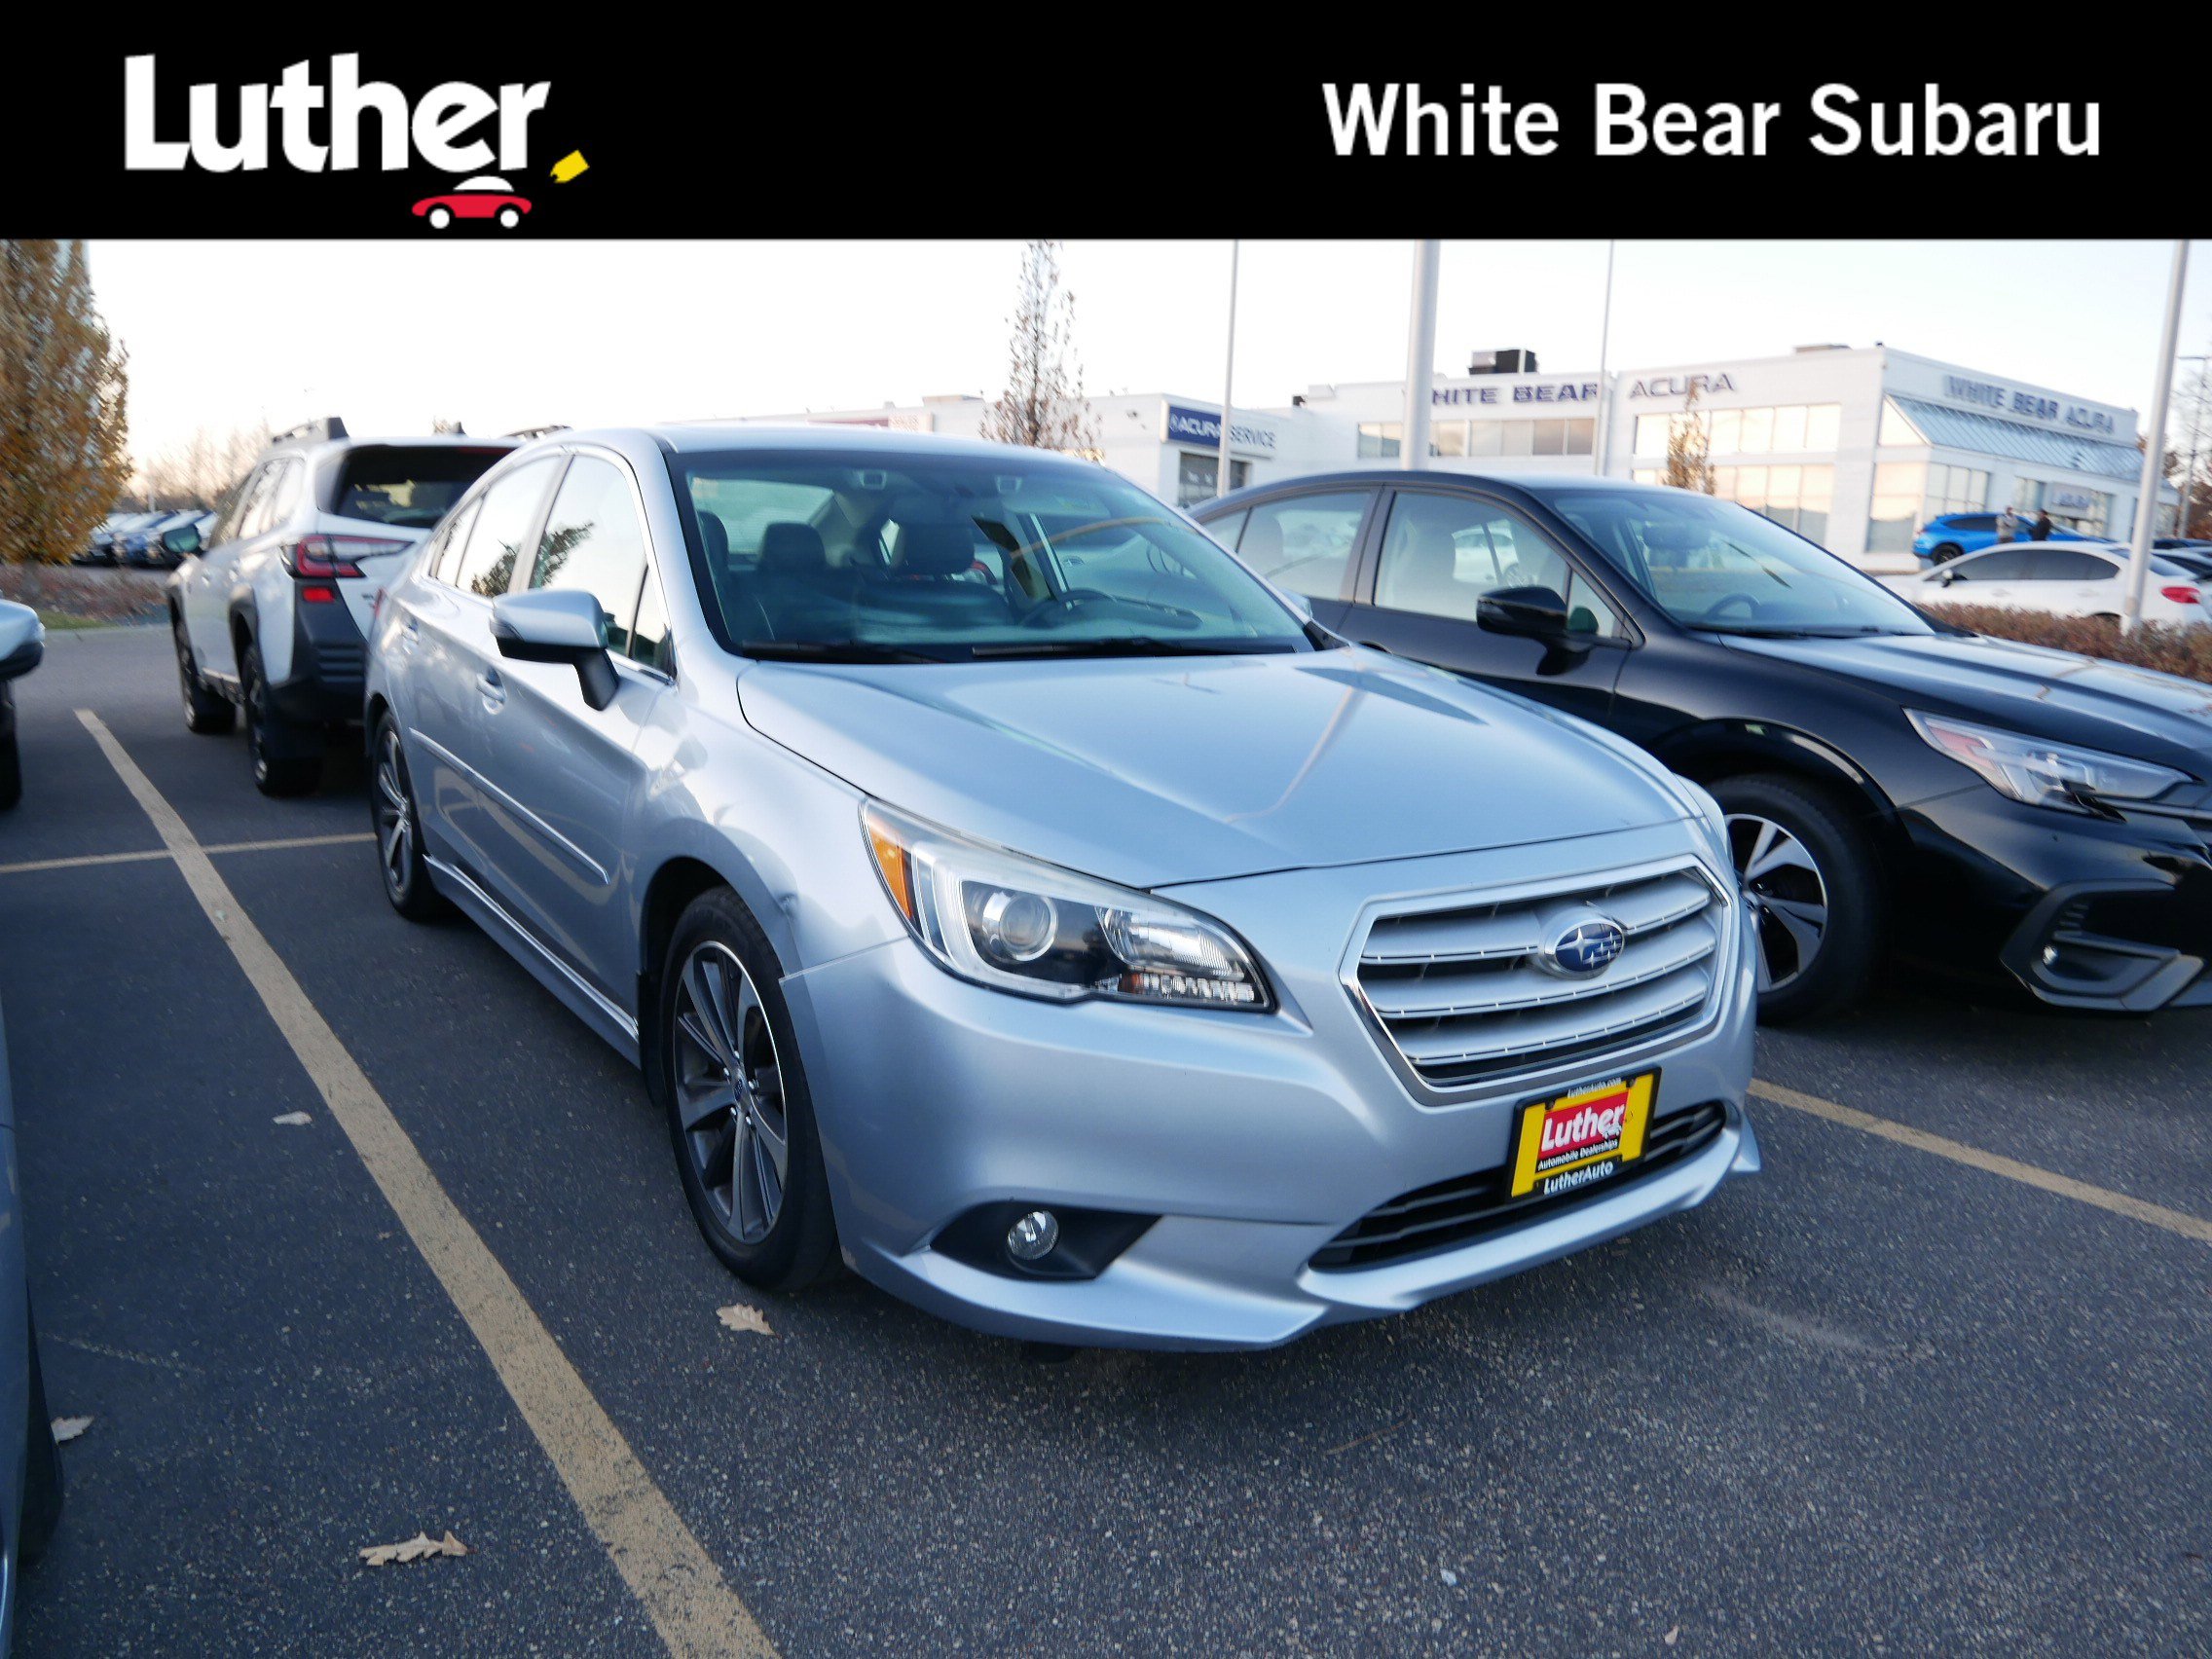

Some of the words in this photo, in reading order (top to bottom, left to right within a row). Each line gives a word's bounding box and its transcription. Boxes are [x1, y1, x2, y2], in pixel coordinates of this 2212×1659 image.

[1429, 387, 1499, 405] HITE
[1513, 384, 1598, 403] BEAR
[1628, 373, 1735, 399] ACURA
[1945, 375, 2006, 409] WHITE
[2012, 390, 2058, 422] BEAR
[2065, 405, 2115, 435] ACURA
[1230, 424, 1277, 449] SERVICE
[1541, 1103, 1625, 1152] Luther
[1537, 1150, 1579, 1171] Automobile
[1579, 1138, 1619, 1159] Dealerships
[1543, 1161, 1614, 1196] LutherAuto
